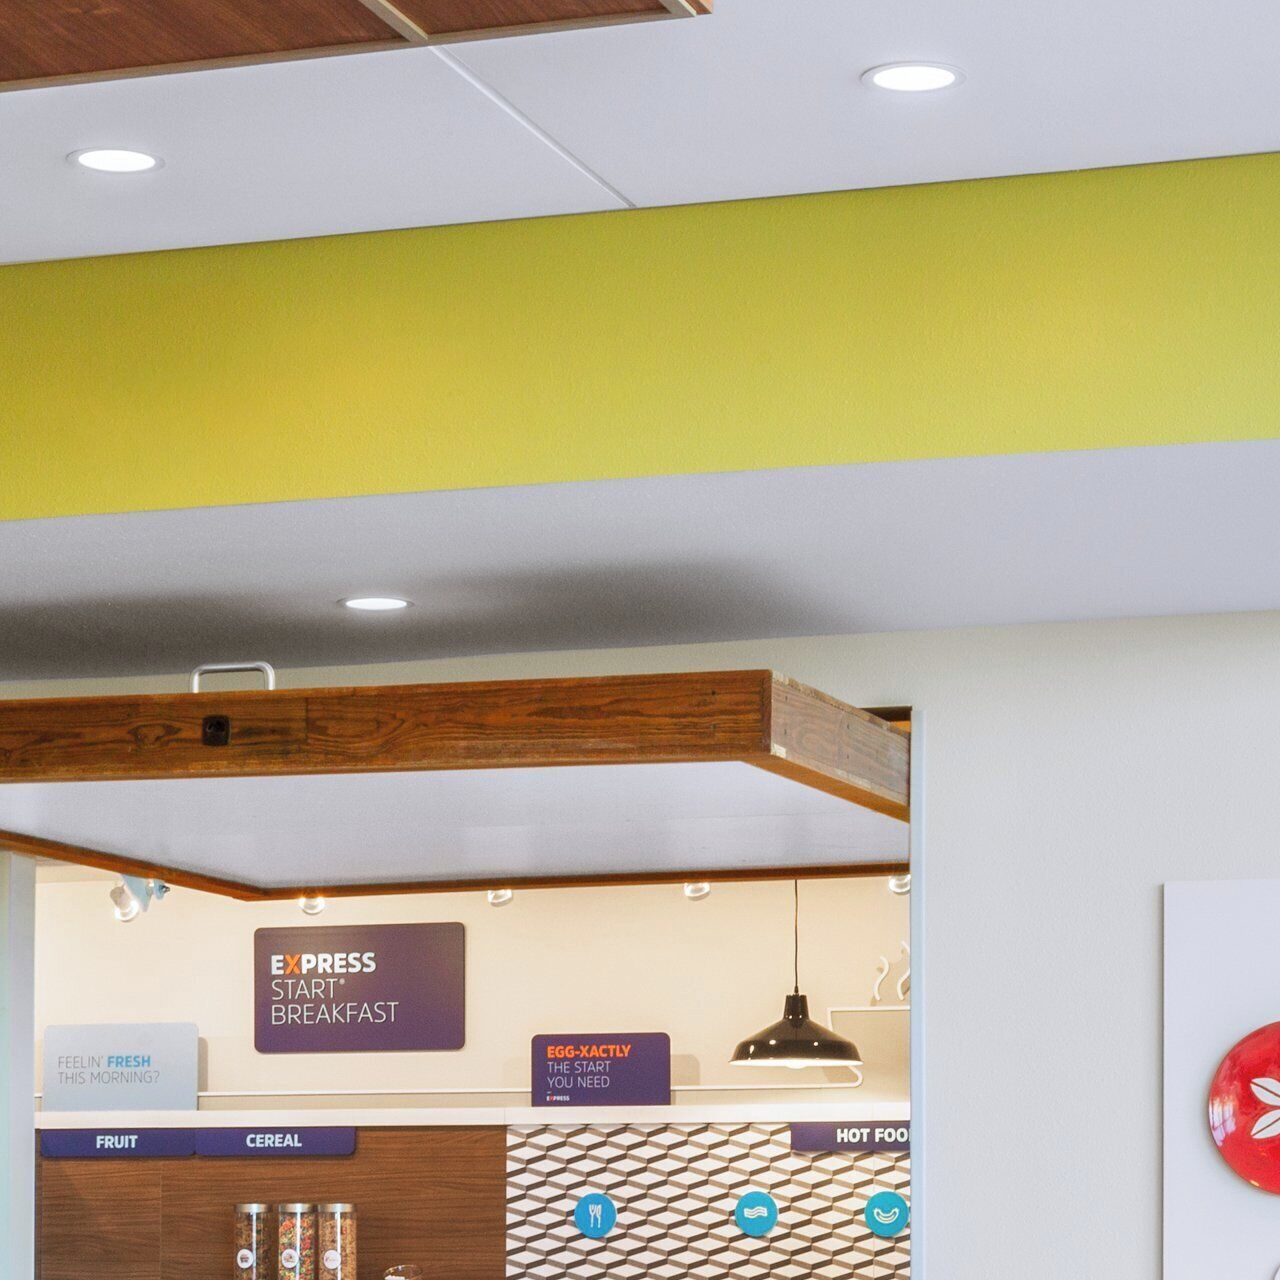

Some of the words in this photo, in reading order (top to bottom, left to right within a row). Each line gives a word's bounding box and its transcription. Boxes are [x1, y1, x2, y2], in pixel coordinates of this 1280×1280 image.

[270, 952, 377, 976] EXPRESS
[271, 1001, 400, 1026] BREAKFAST
[546, 1044, 632, 1059] EGG-XACTLY
[57, 1055, 104, 1069] FEELIN'
[106, 1055, 152, 1068] FRESH
[546, 1061, 571, 1074] THE
[574, 1060, 612, 1074] START
[57, 1071, 86, 1085] THIS
[89, 1070, 161, 1085] MORNING?
[546, 1076, 573, 1089] YOU
[577, 1075, 611, 1089] NEED
[95, 1134, 139, 1149] FRUIT
[245, 1133, 303, 1148] CEREAL
[836, 1128, 871, 1143] HOT
[874, 1127, 911, 1143] FOO
